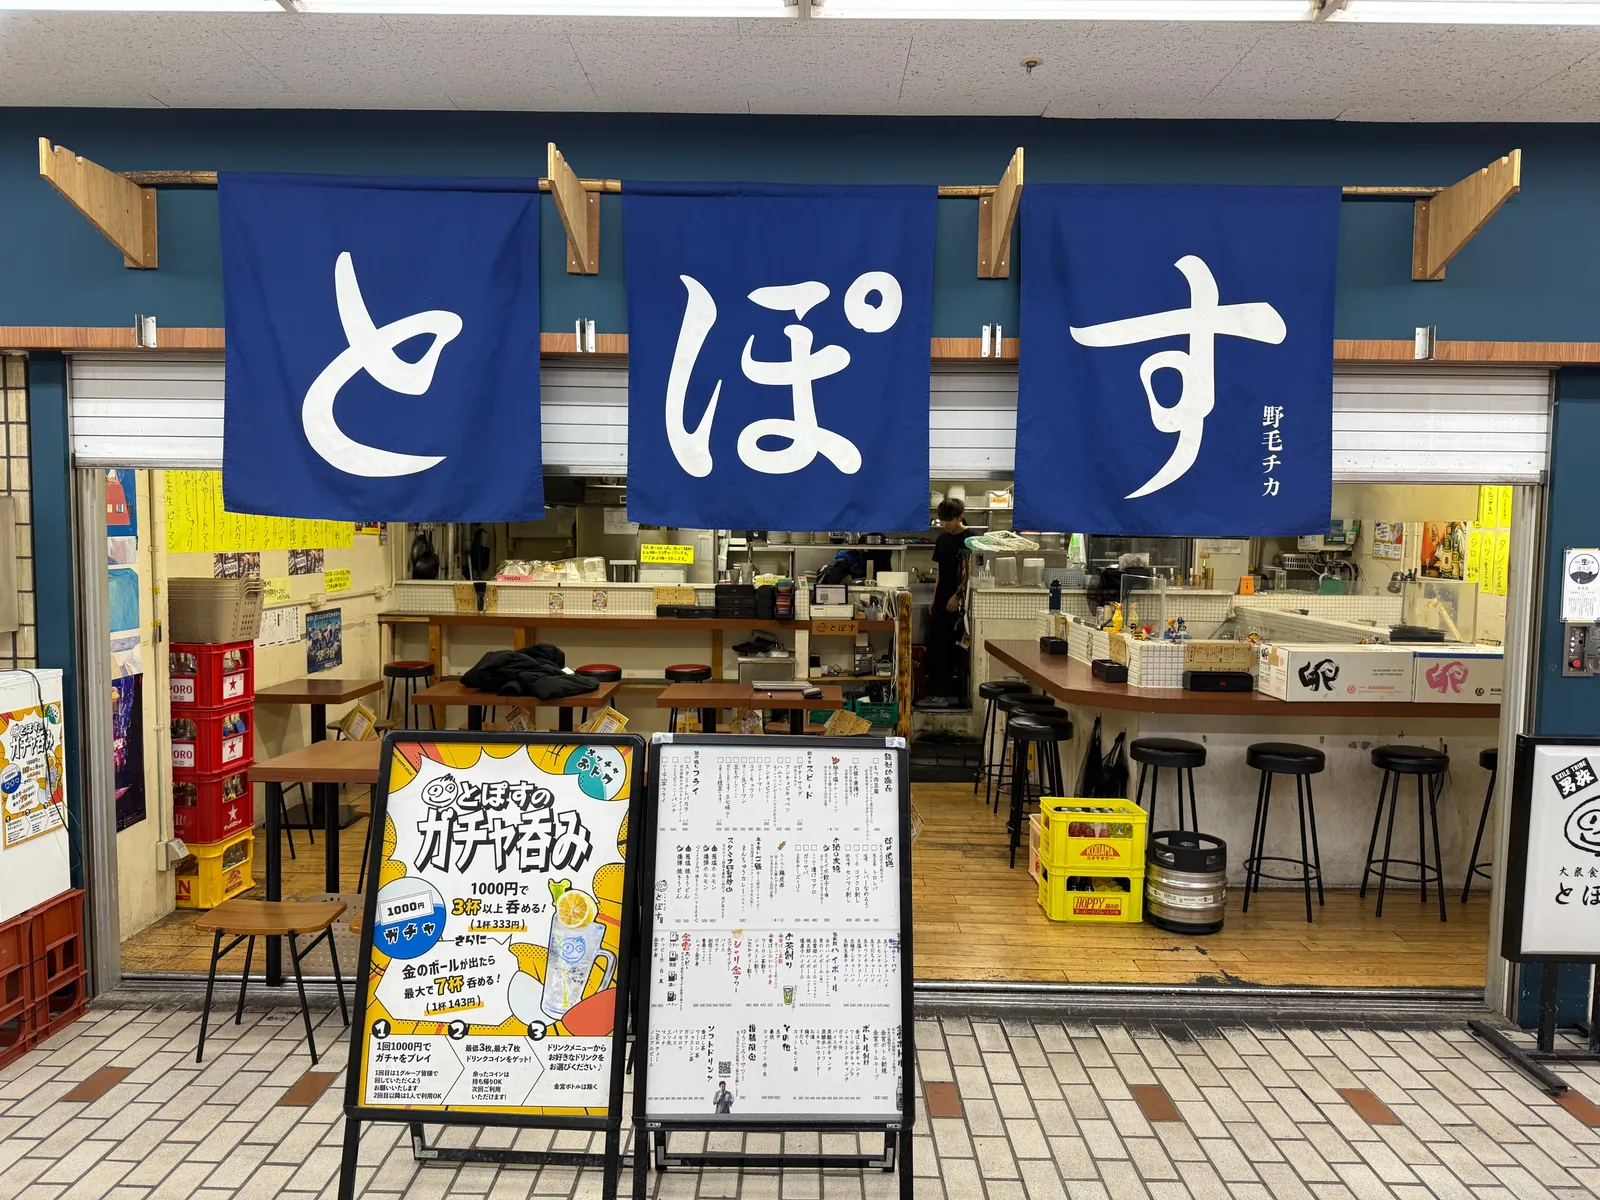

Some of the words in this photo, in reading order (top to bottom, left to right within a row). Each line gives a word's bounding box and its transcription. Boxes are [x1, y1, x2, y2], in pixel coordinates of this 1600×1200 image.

[1261, 405, 1284, 497] 野毛チカ
[830, 624, 856, 632] とぽす
[10, 732, 54, 761] ガチャ呑み
[577, 757, 614, 785] おトク
[1554, 768, 1571, 781] EXILE
[1571, 760, 1588, 774] TRIBE
[1558, 768, 1595, 797] 男旅
[457, 780, 555, 810] とぽすの
[413, 806, 594, 874] ガチャ呑み
[1086, 845, 1114, 857] KODAMA
[471, 881, 529, 897] 1000円で
[387, 901, 425, 917] 1000円
[1075, 897, 1106, 910] HOPPY
[383, 922, 436, 944] ガチャ
[454, 934, 487, 947] さらに
[785, 933, 794, 969] お茶割り
[401, 954, 497, 980] 金のボールが出たら
[731, 940, 742, 993] シャリ金サワー
[375, 1020, 387, 1037] 1
[450, 1021, 465, 1039] 2
[531, 1022, 545, 1040] 3
[782, 1024, 791, 1051] その他
[376, 1041, 432, 1052] 1回1000円で
[547, 1043, 607, 1053] ドリンクメニューから
[707, 1025, 715, 1082] ソフトドリンク
[375, 1054, 431, 1064] ガチャをプレイ
[465, 1054, 532, 1064] ドリンクコインをゲット!
[548, 1053, 605, 1062] お好きなドリンクを
[374, 1069, 439, 1078] 1回目は1グループ皆様で
[374, 1076, 421, 1085] 回していただくよう
[472, 1070, 510, 1078] 余ったコインは
[373, 1092, 443, 1100] 2回目以降は1人で利用OK
[374, 1084, 419, 1092] お願いいたします
[471, 1085, 501, 1093] 次回ご利用
[471, 1093, 507, 1101] いただけます!
